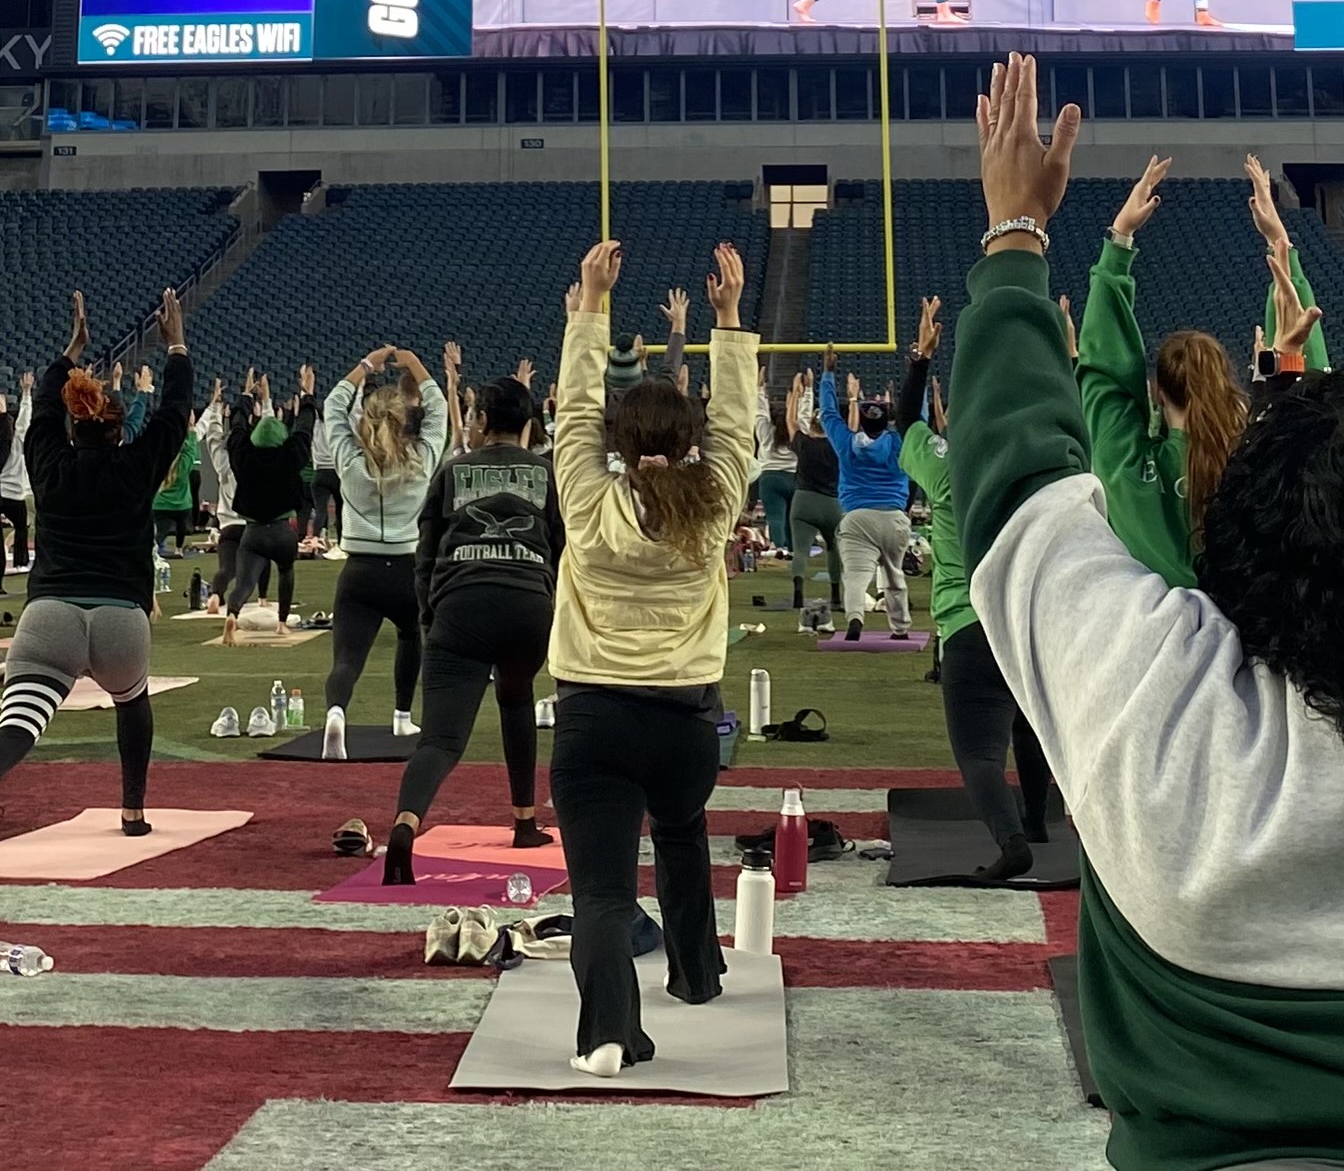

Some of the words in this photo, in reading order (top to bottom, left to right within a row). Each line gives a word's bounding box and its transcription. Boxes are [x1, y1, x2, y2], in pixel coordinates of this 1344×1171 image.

[132, 25, 179, 55] FREE
[183, 23, 254, 54] EAGLES
[256, 22, 301, 53] WIFI
[452, 464, 548, 511] EAGLES
[453, 543, 513, 561] FOOTBALL
